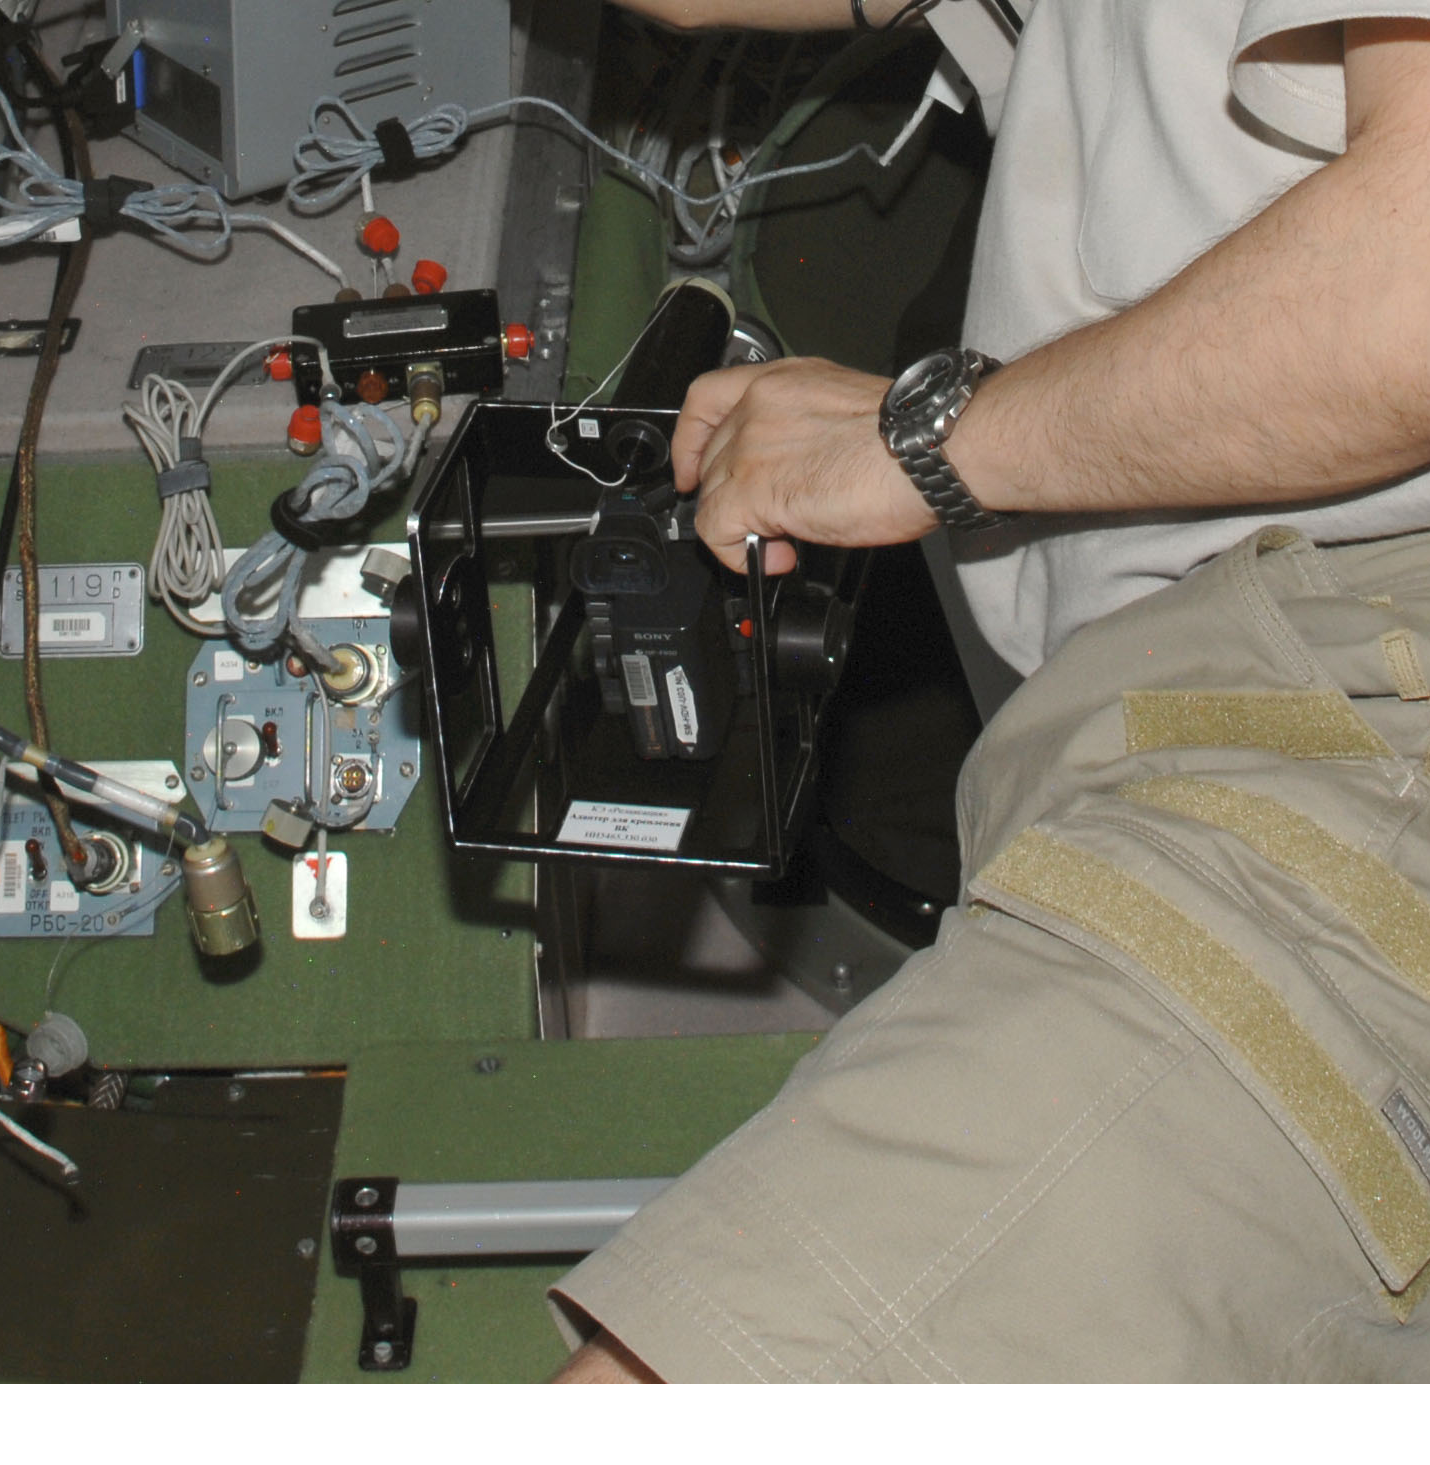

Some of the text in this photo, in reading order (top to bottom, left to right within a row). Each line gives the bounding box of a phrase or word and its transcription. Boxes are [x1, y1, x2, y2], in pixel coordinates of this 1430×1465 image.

[51, 573, 102, 598] 119
[633, 632, 673, 641] SONY
[30, 915, 105, 932] РБС-20
